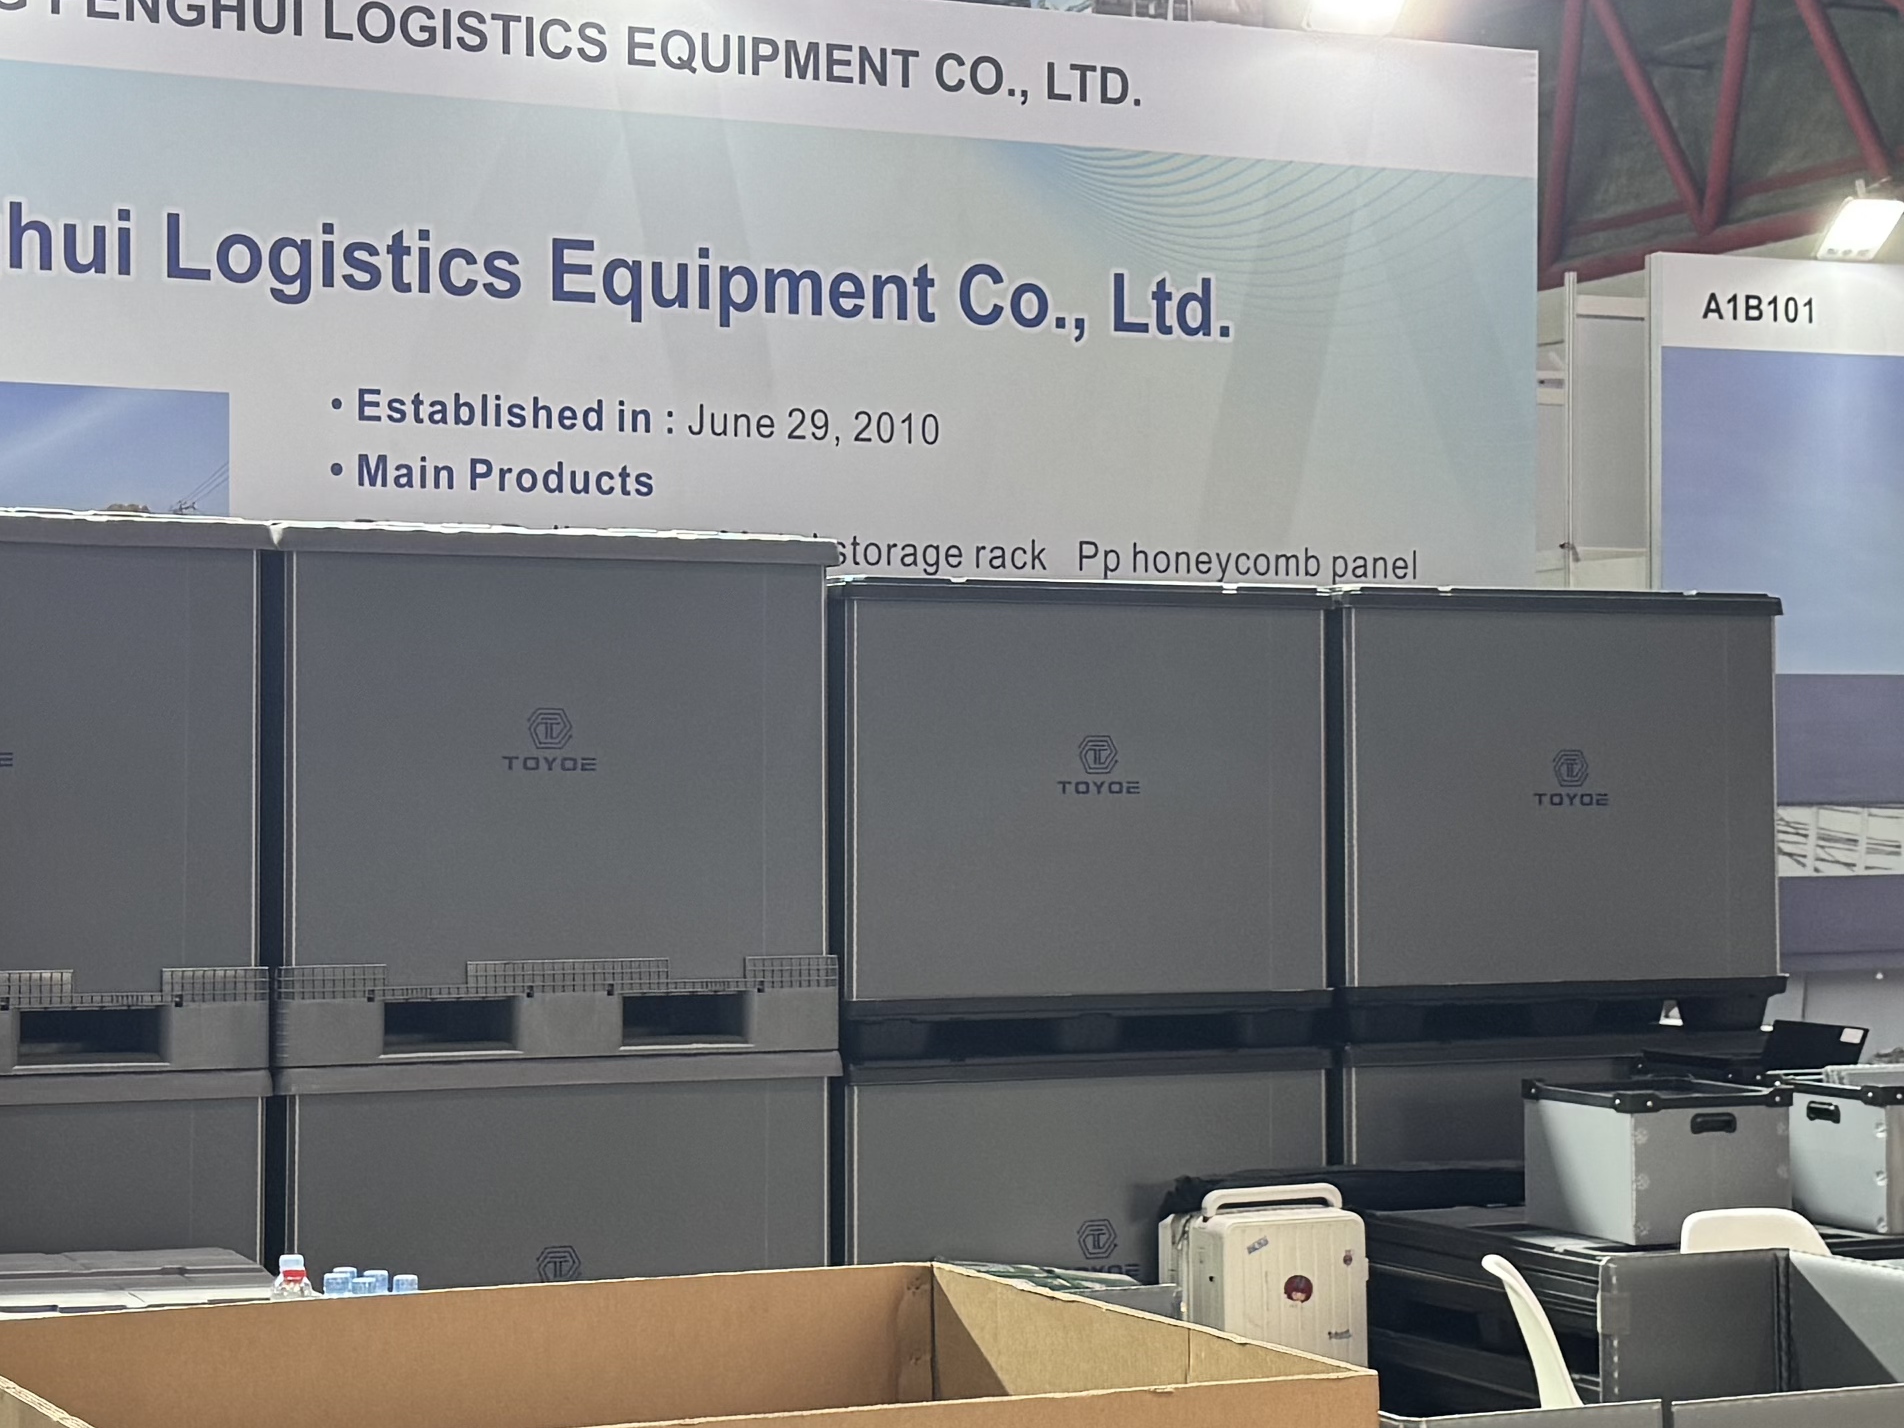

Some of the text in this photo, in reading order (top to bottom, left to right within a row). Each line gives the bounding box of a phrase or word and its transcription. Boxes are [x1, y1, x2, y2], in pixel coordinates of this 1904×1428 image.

[628, 25, 919, 89] EQUIPMENT
[935, 52, 1028, 106] CO.,
[1047, 61, 1141, 107] LTD.
[167, 212, 521, 306] Logistics
[552, 237, 935, 329] Equipment
[959, 263, 1085, 343] Co.,
[1112, 269, 1233, 339] Ltd.
[1702, 291, 1817, 327] A1B101
[358, 388, 939, 448] Established in : June 29, 2010
[358, 453, 653, 497] Main Products
[834, 536, 1419, 586] storage rack Pp honeycomb panel
[501, 755, 597, 773] TOYOE
[1057, 780, 1142, 796] TOYOE
[1533, 792, 1611, 807] TOYOE
